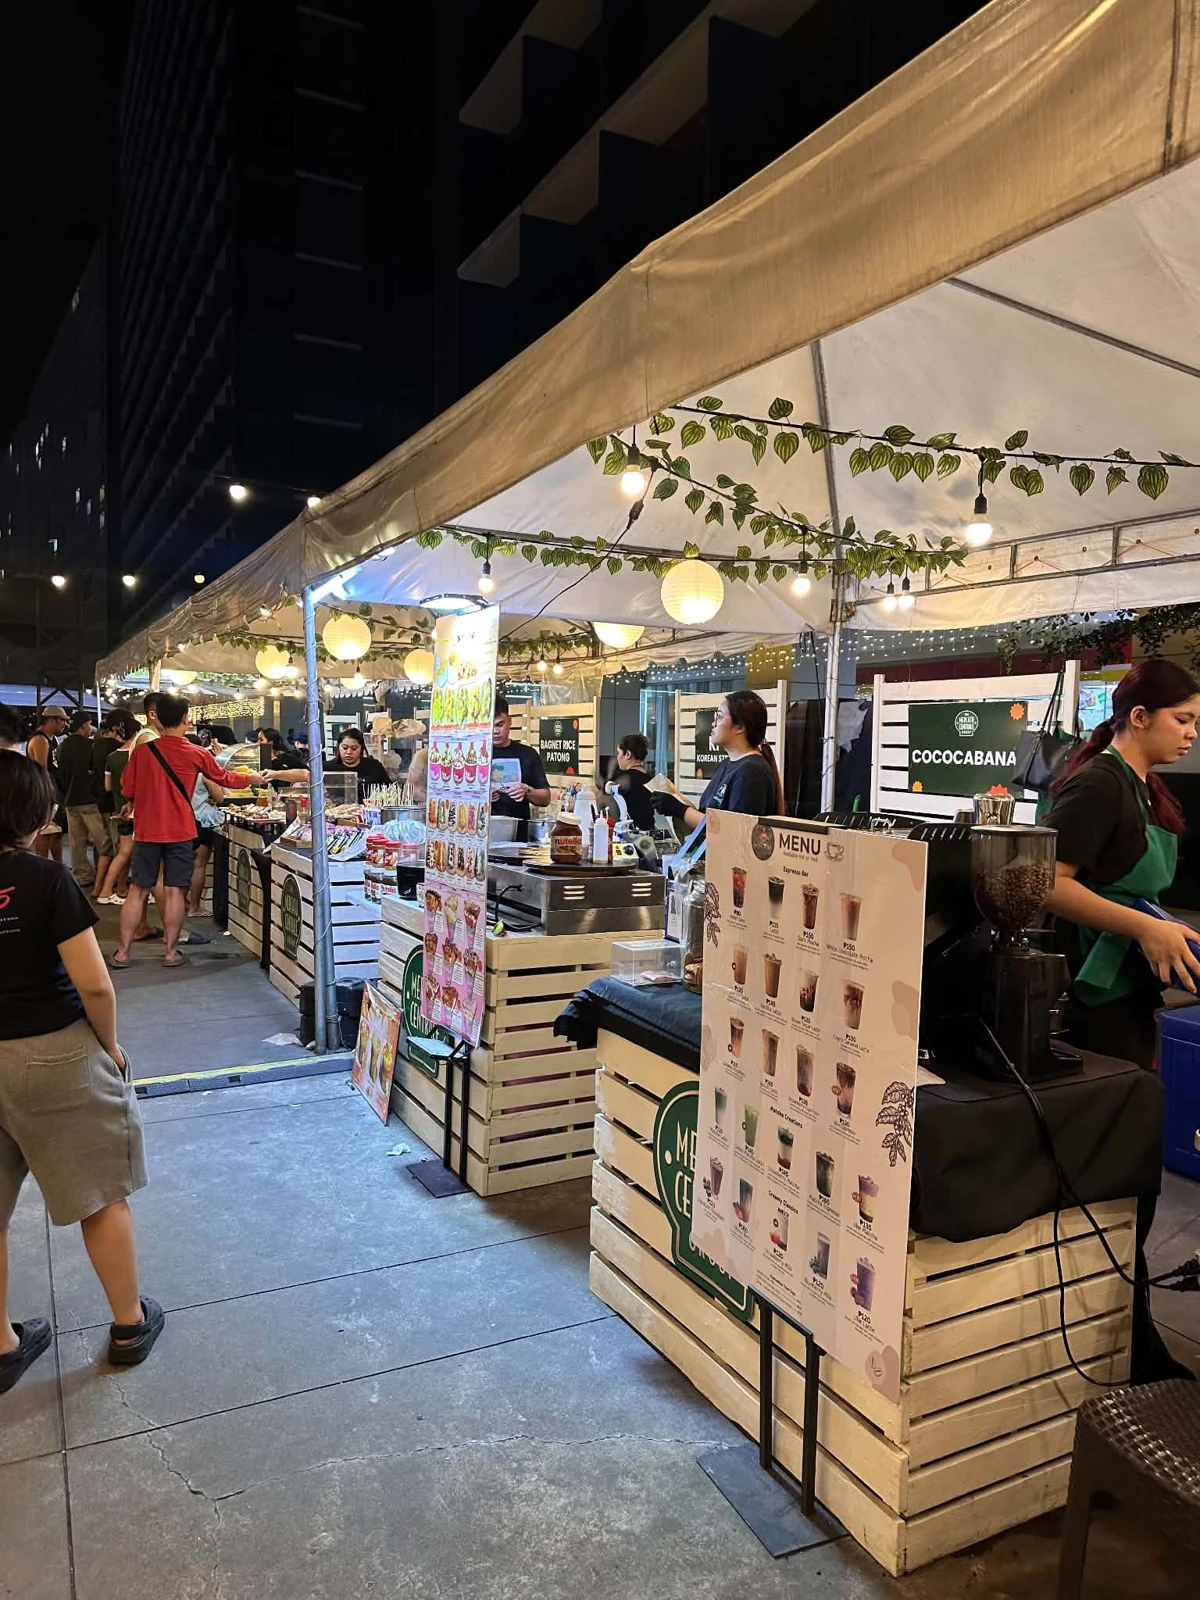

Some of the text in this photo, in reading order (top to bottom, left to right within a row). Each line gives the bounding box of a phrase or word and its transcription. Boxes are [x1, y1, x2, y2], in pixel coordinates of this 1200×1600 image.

[540, 739, 576, 750] BAGNET RICE
[546, 751, 571, 763] PATONG
[696, 754, 718, 763] KOREAN
[911, 749, 1017, 767] COCOCABANA
[778, 833, 821, 856] MENU
[782, 865, 809, 877] Espresso Bar
[768, 1188, 782, 1205] Creamy
[782, 1198, 798, 1215] Classics
[859, 1217, 871, 1232] ₱135
[857, 1309, 871, 1325] ₱120
